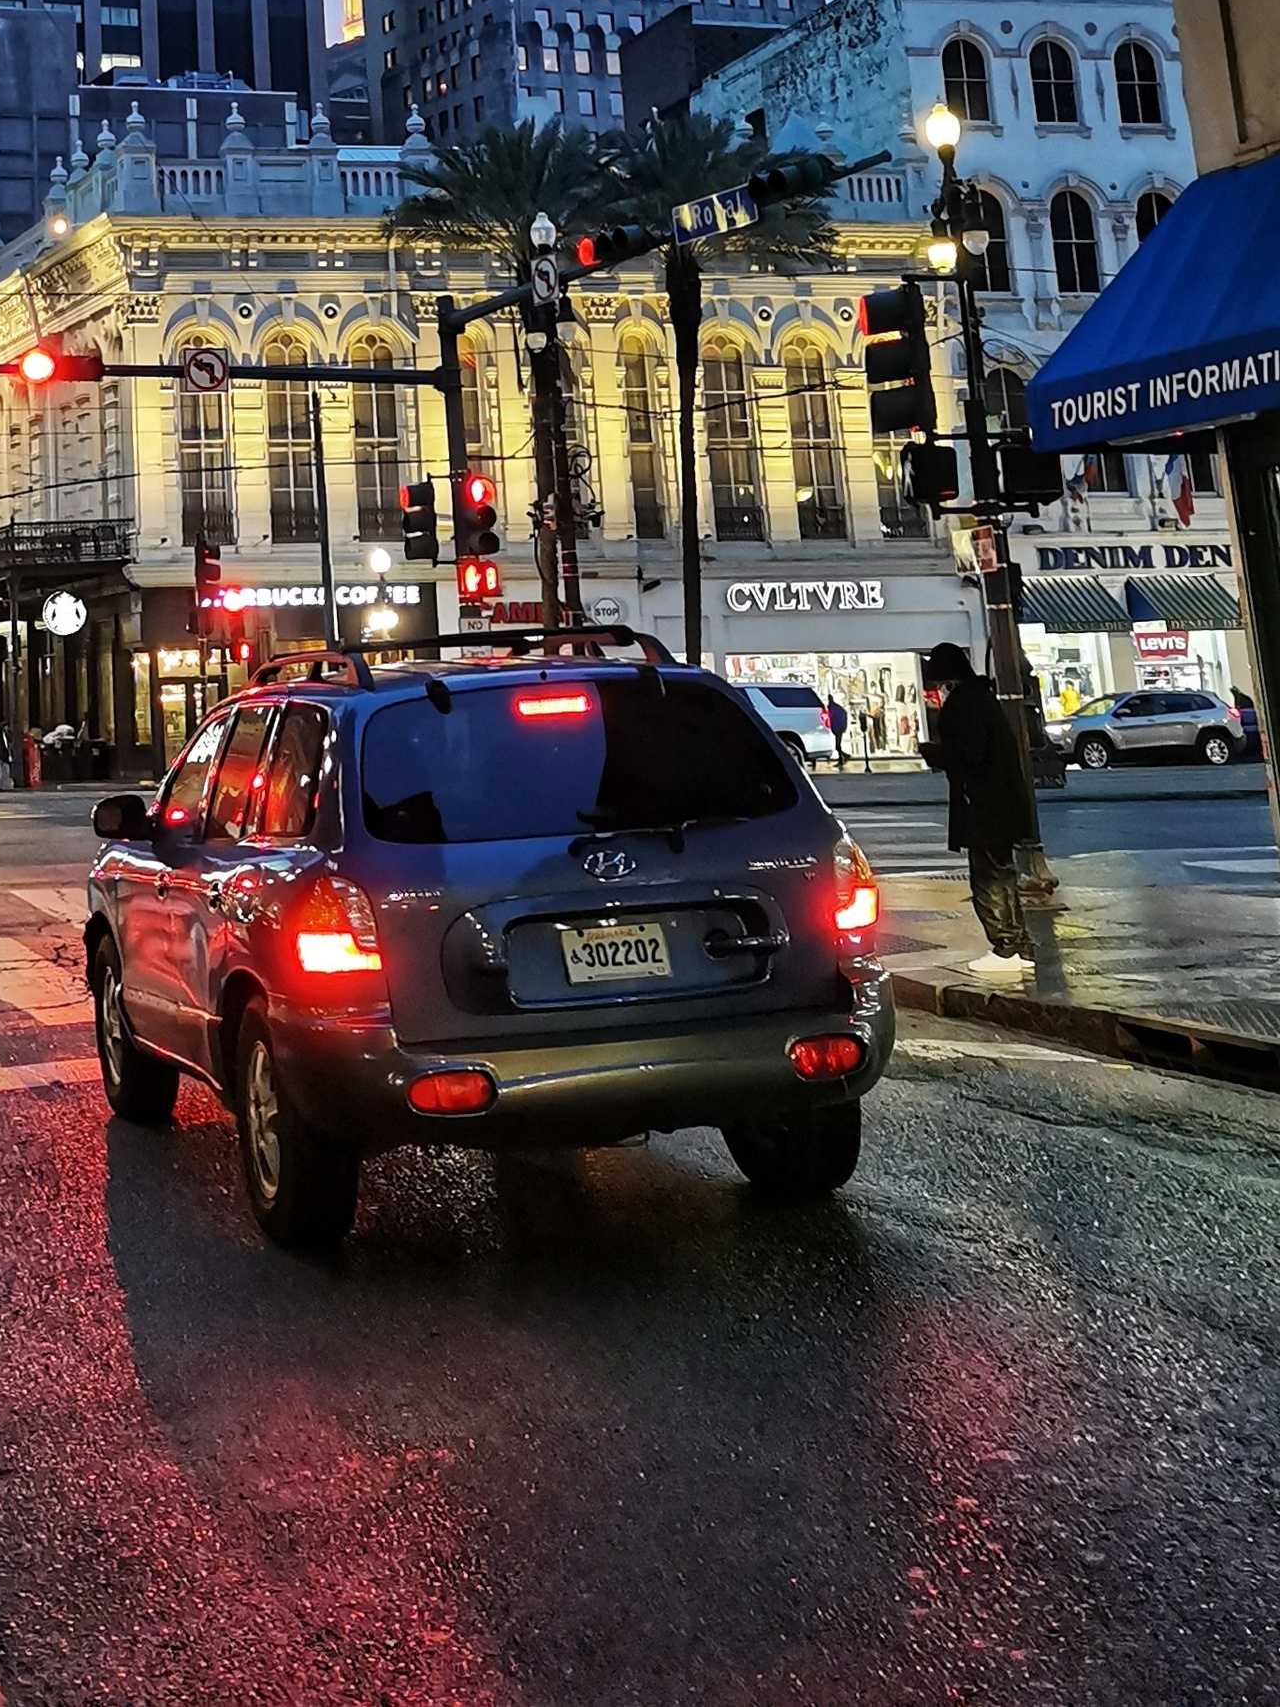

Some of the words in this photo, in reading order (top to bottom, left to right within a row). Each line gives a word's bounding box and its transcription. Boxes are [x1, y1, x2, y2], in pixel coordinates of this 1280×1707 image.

[691, 191, 741, 230] Roal
[1050, 382, 1141, 430] TOURIST
[1149, 349, 1280, 409] INFORMATI
[1036, 545, 1155, 570] DENIM
[1163, 544, 1234, 568] DEN
[594, 607, 619, 617] STOP
[726, 581, 885, 612] CVLTVRE
[467, 621, 483, 631] NO
[582, 937, 664, 968] 302202
